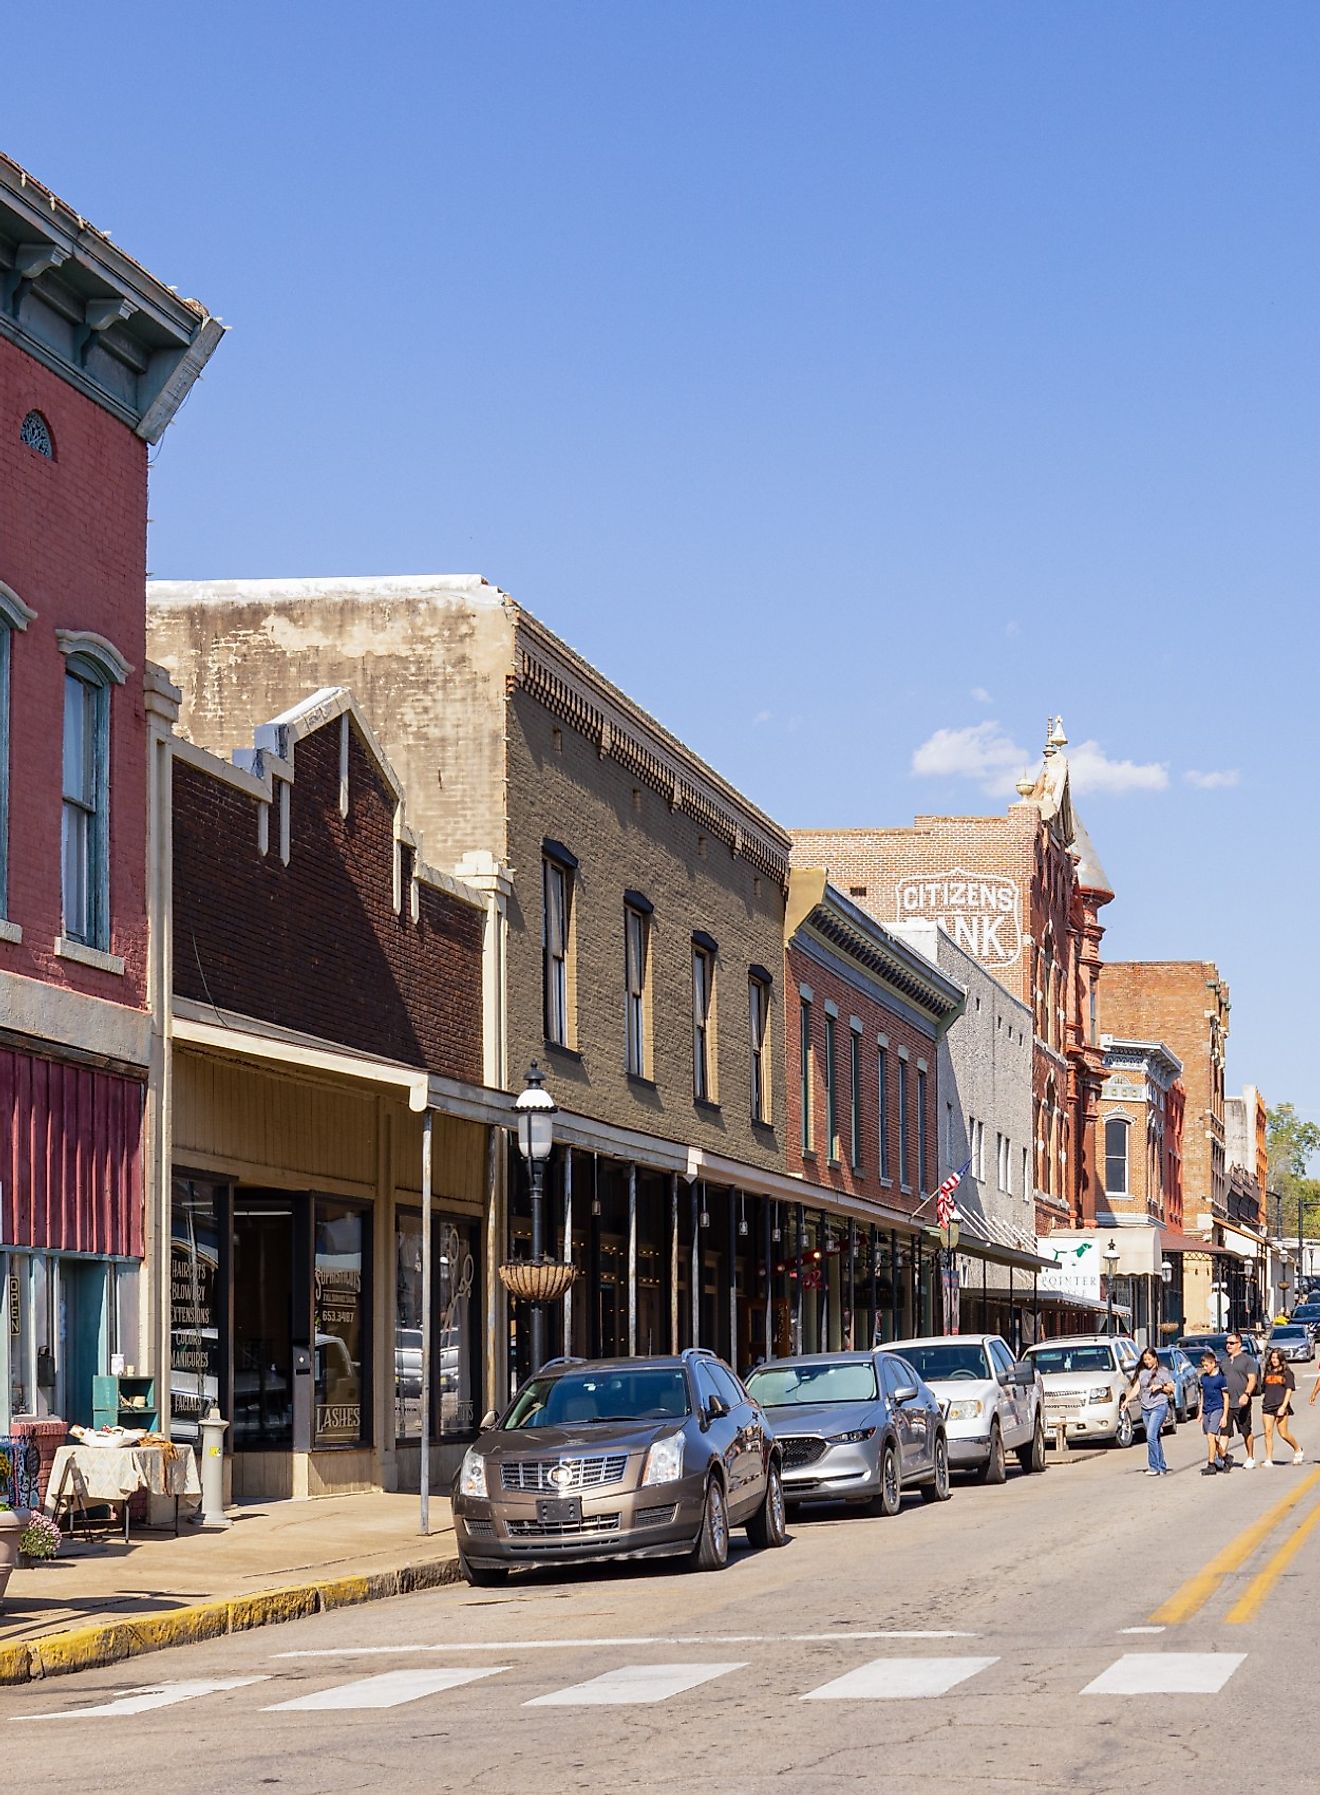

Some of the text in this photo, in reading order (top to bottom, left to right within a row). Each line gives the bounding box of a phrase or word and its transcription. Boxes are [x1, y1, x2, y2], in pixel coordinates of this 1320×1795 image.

[903, 883, 1013, 911] CITIZENS
[171, 1259, 206, 1279] HAIRCUTS
[1042, 1276, 1096, 1286] POINTER
[11, 1280, 19, 1333] OPEN
[176, 1327, 202, 1346] COLORS
[174, 1395, 202, 1413] FACIALS
[316, 1407, 361, 1433] LASHES
